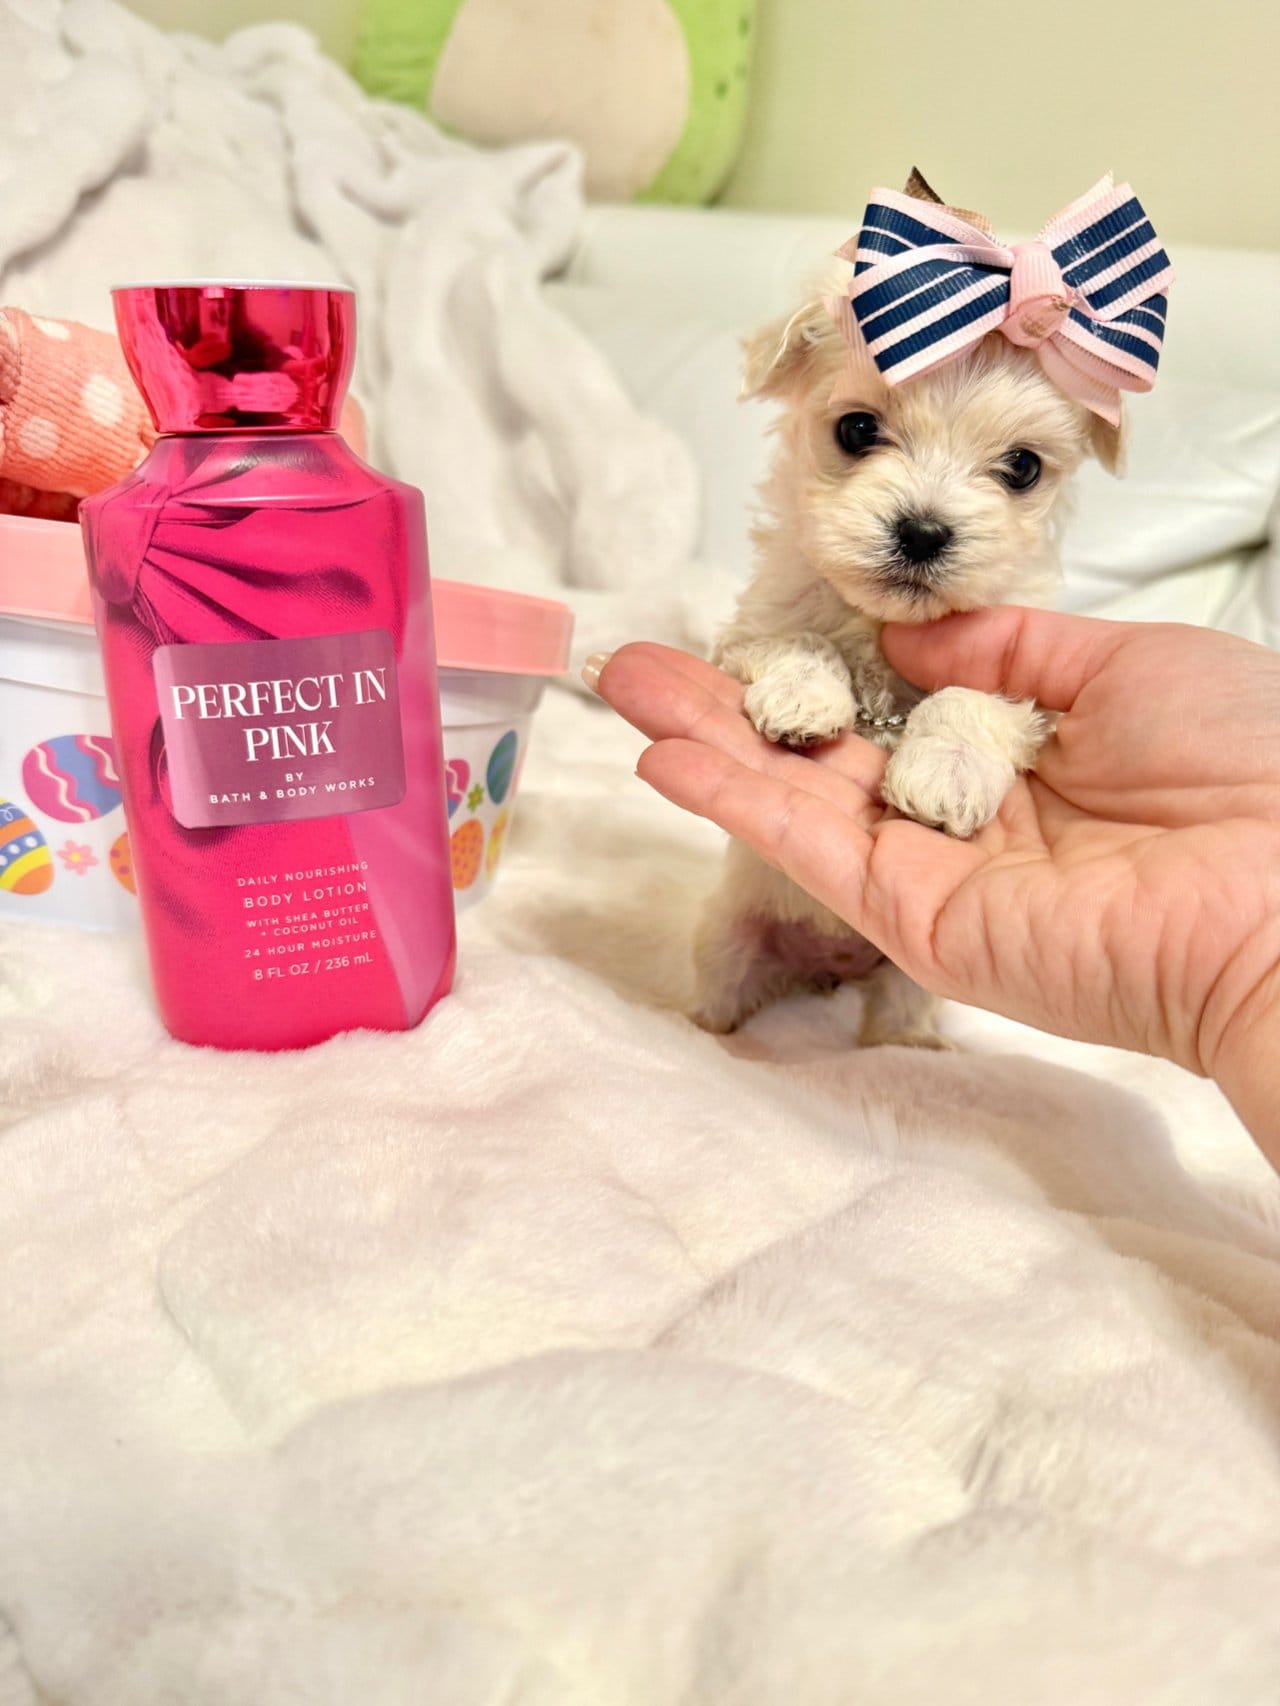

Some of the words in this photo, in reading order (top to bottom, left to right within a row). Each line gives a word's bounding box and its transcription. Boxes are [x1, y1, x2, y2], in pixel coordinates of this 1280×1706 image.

[169, 673, 344, 720] PERFECT
[352, 667, 387, 705] IN
[242, 721, 336, 762] PINK
[210, 792, 251, 804] BATH
[259, 791, 268, 801] &
[276, 785, 317, 798] BODY
[325, 777, 376, 792] WORKS
[285, 772, 304, 783] BY
[237, 874, 278, 887] DAILY
[285, 861, 369, 882] NOURISHING
[244, 892, 293, 909] BODY
[303, 881, 367, 902] LOTION
[247, 917, 279, 928] WITH
[285, 912, 318, 924] SHEA
[323, 903, 369, 918] BUTTER
[273, 920, 333, 937] COCONUT
[339, 917, 359, 927] OIL
[245, 949, 260, 958] 24
[267, 942, 305, 956] HOUR
[311, 930, 377, 949] MOISTURE
[254, 969, 263, 981] 8
[267, 967, 285, 978] FL
[289, 962, 309, 975] OZ
[314, 959, 321, 974] /
[325, 956, 350, 970] 236
[353, 952, 373, 965] mL
